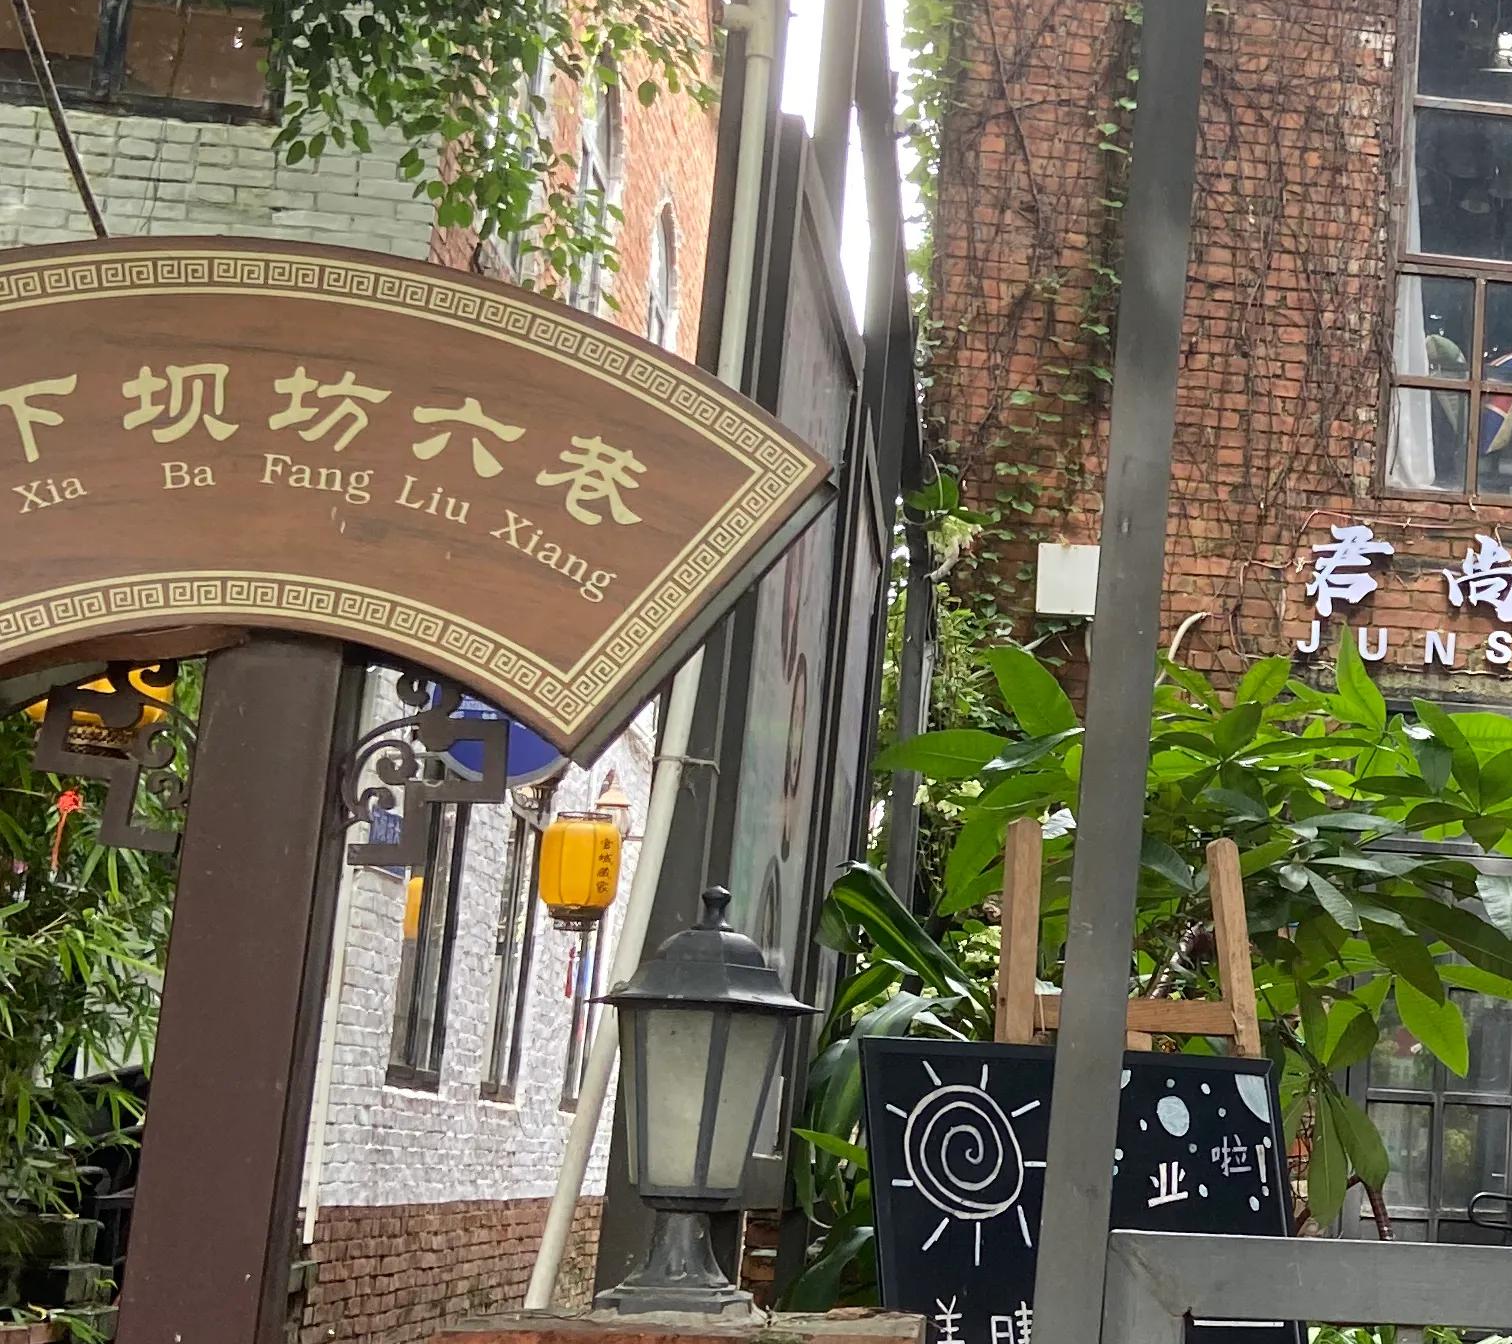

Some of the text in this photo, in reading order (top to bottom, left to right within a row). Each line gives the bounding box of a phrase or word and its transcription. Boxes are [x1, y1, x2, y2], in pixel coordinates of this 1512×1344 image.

[0, 362, 646, 527] 下坝坊六巷
[13, 453, 618, 603] Xia Ba Fang Liu Xiang
